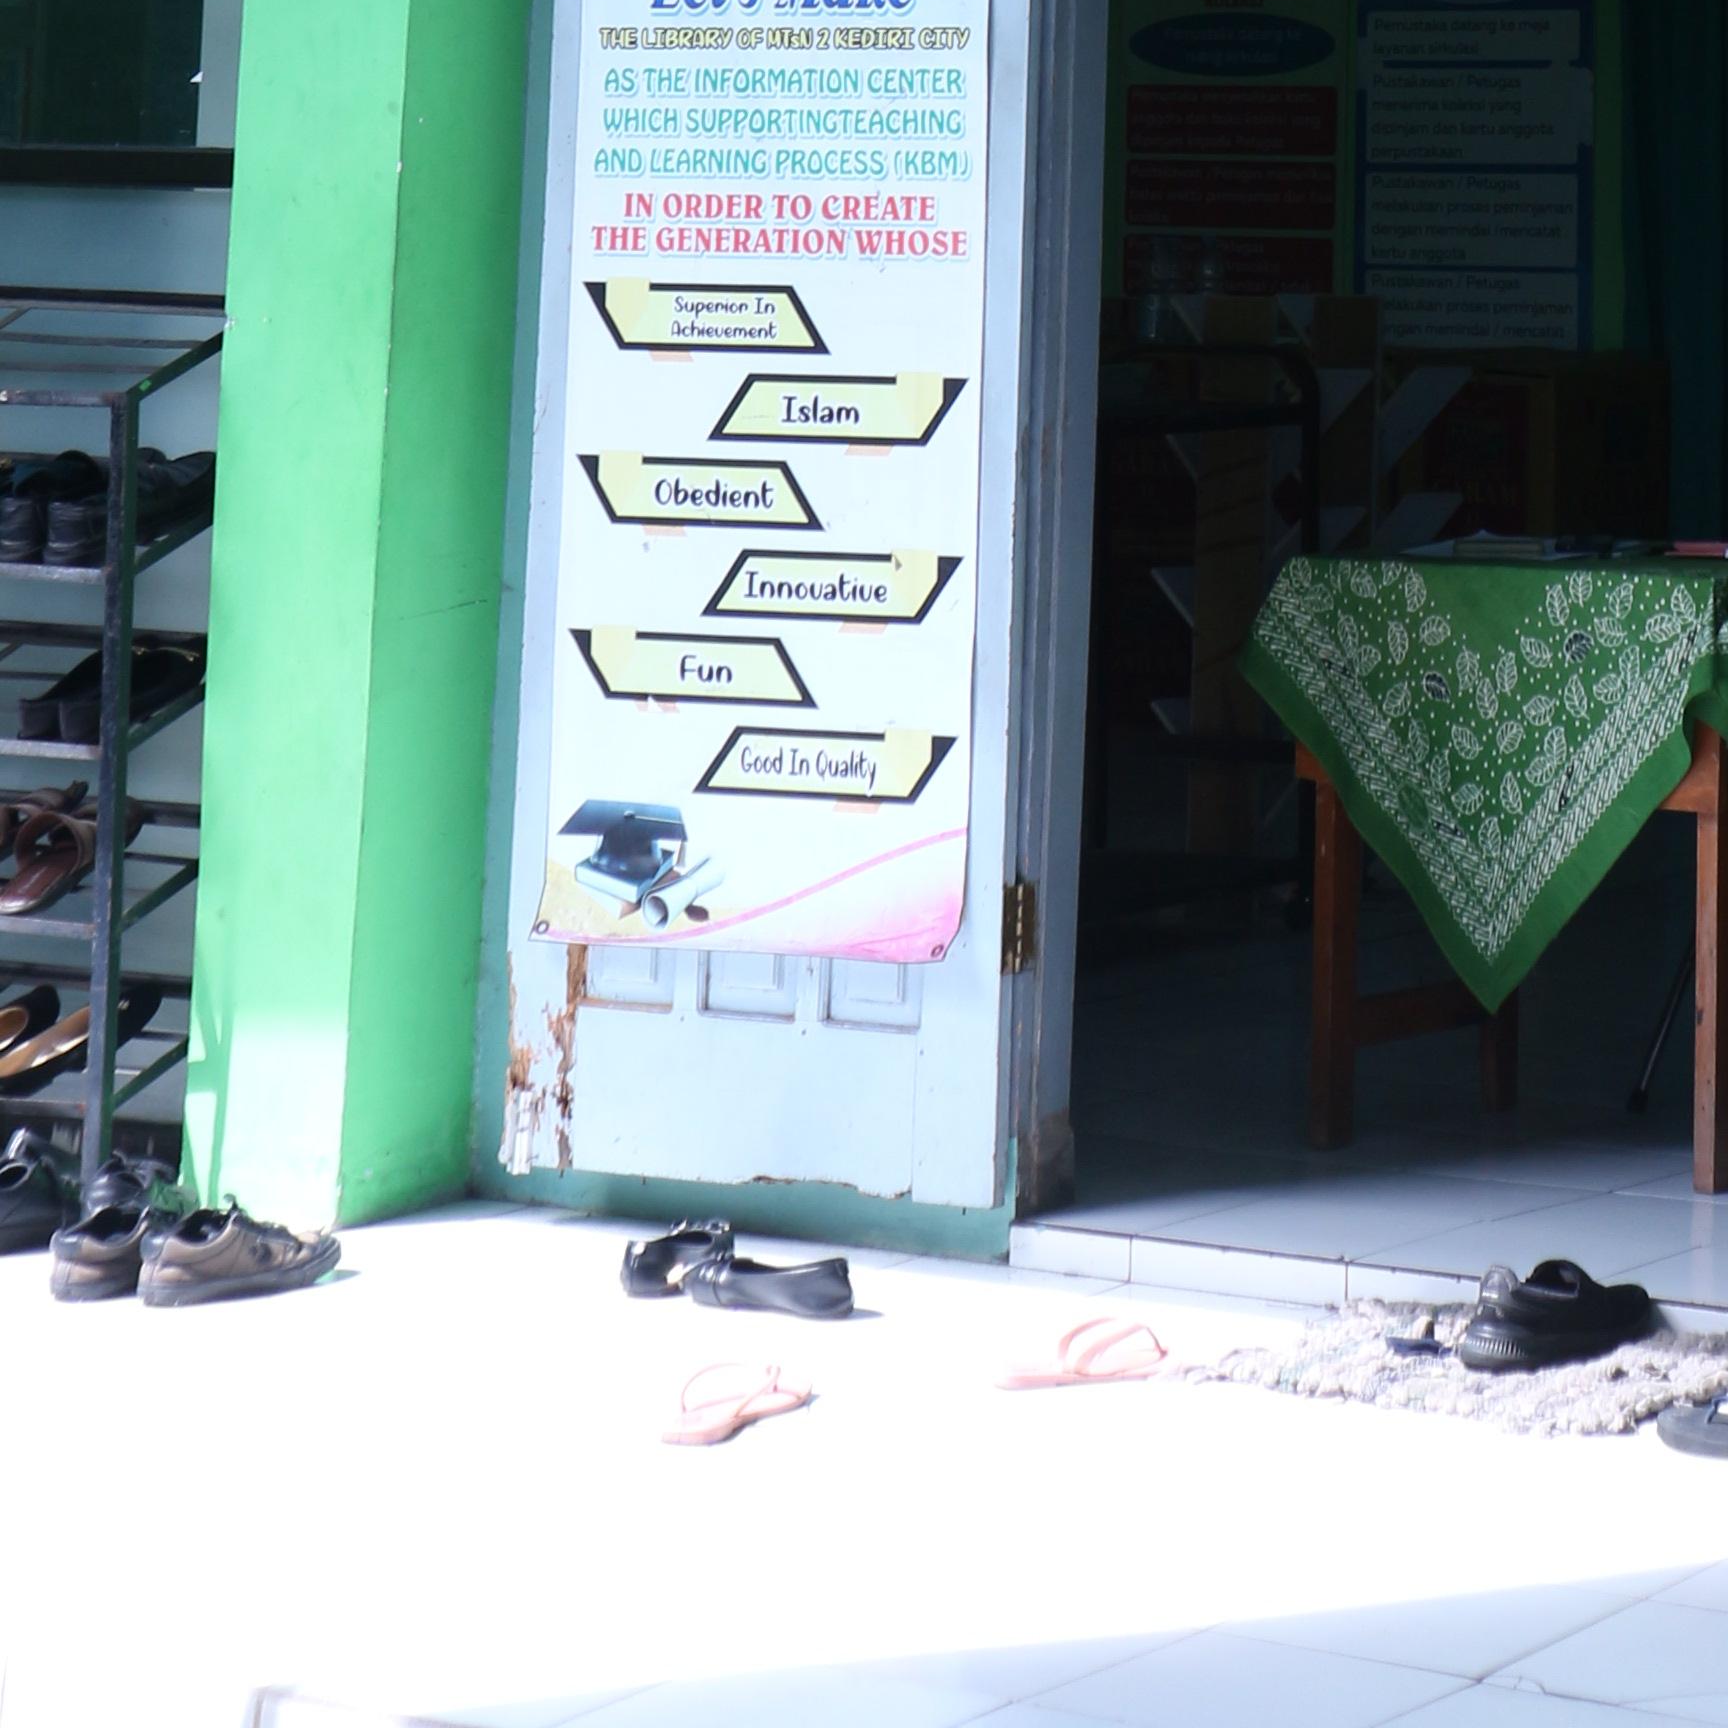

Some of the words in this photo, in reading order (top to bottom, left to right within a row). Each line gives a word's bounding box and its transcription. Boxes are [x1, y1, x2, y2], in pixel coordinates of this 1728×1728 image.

[599, 27, 638, 50] THE
[641, 27, 733, 50] LIBRARY
[736, 27, 764, 50] OF
[816, 27, 830, 50] 2
[833, 27, 914, 50] KEDIRI
[918, 27, 970, 50] CITY
[604, 68, 636, 93] AS
[643, 68, 687, 93] THE
[694, 68, 859, 94] INFORMATION
[867, 68, 963, 94] CENTER
[603, 108, 679, 133] WHICH
[594, 148, 643, 173] AND
[650, 149, 768, 174] LEARNING
[775, 150, 885, 175] PROCESS
[894, 150, 970, 176] (KBM)
[624, 193, 654, 218] IN
[663, 193, 764, 219] ORDER
[772, 194, 813, 220] TO
[821, 195, 937, 222] CREATE
[592, 226, 647, 251] THE
[655, 227, 847, 254] GENERATION
[853, 229, 969, 256] WHOSE
[674, 296, 748, 318] Superior
[753, 297, 776, 314] In
[1378, 299, 1443, 313] elakukan
[670, 320, 778, 340] Achievement
[781, 395, 860, 425] Islam
[655, 477, 774, 509] Obedient
[744, 570, 888, 603] Innovative
[679, 654, 733, 683] Fun
[741, 746, 783, 775] Good
[789, 748, 810, 776] In
[816, 749, 876, 790] Quality
